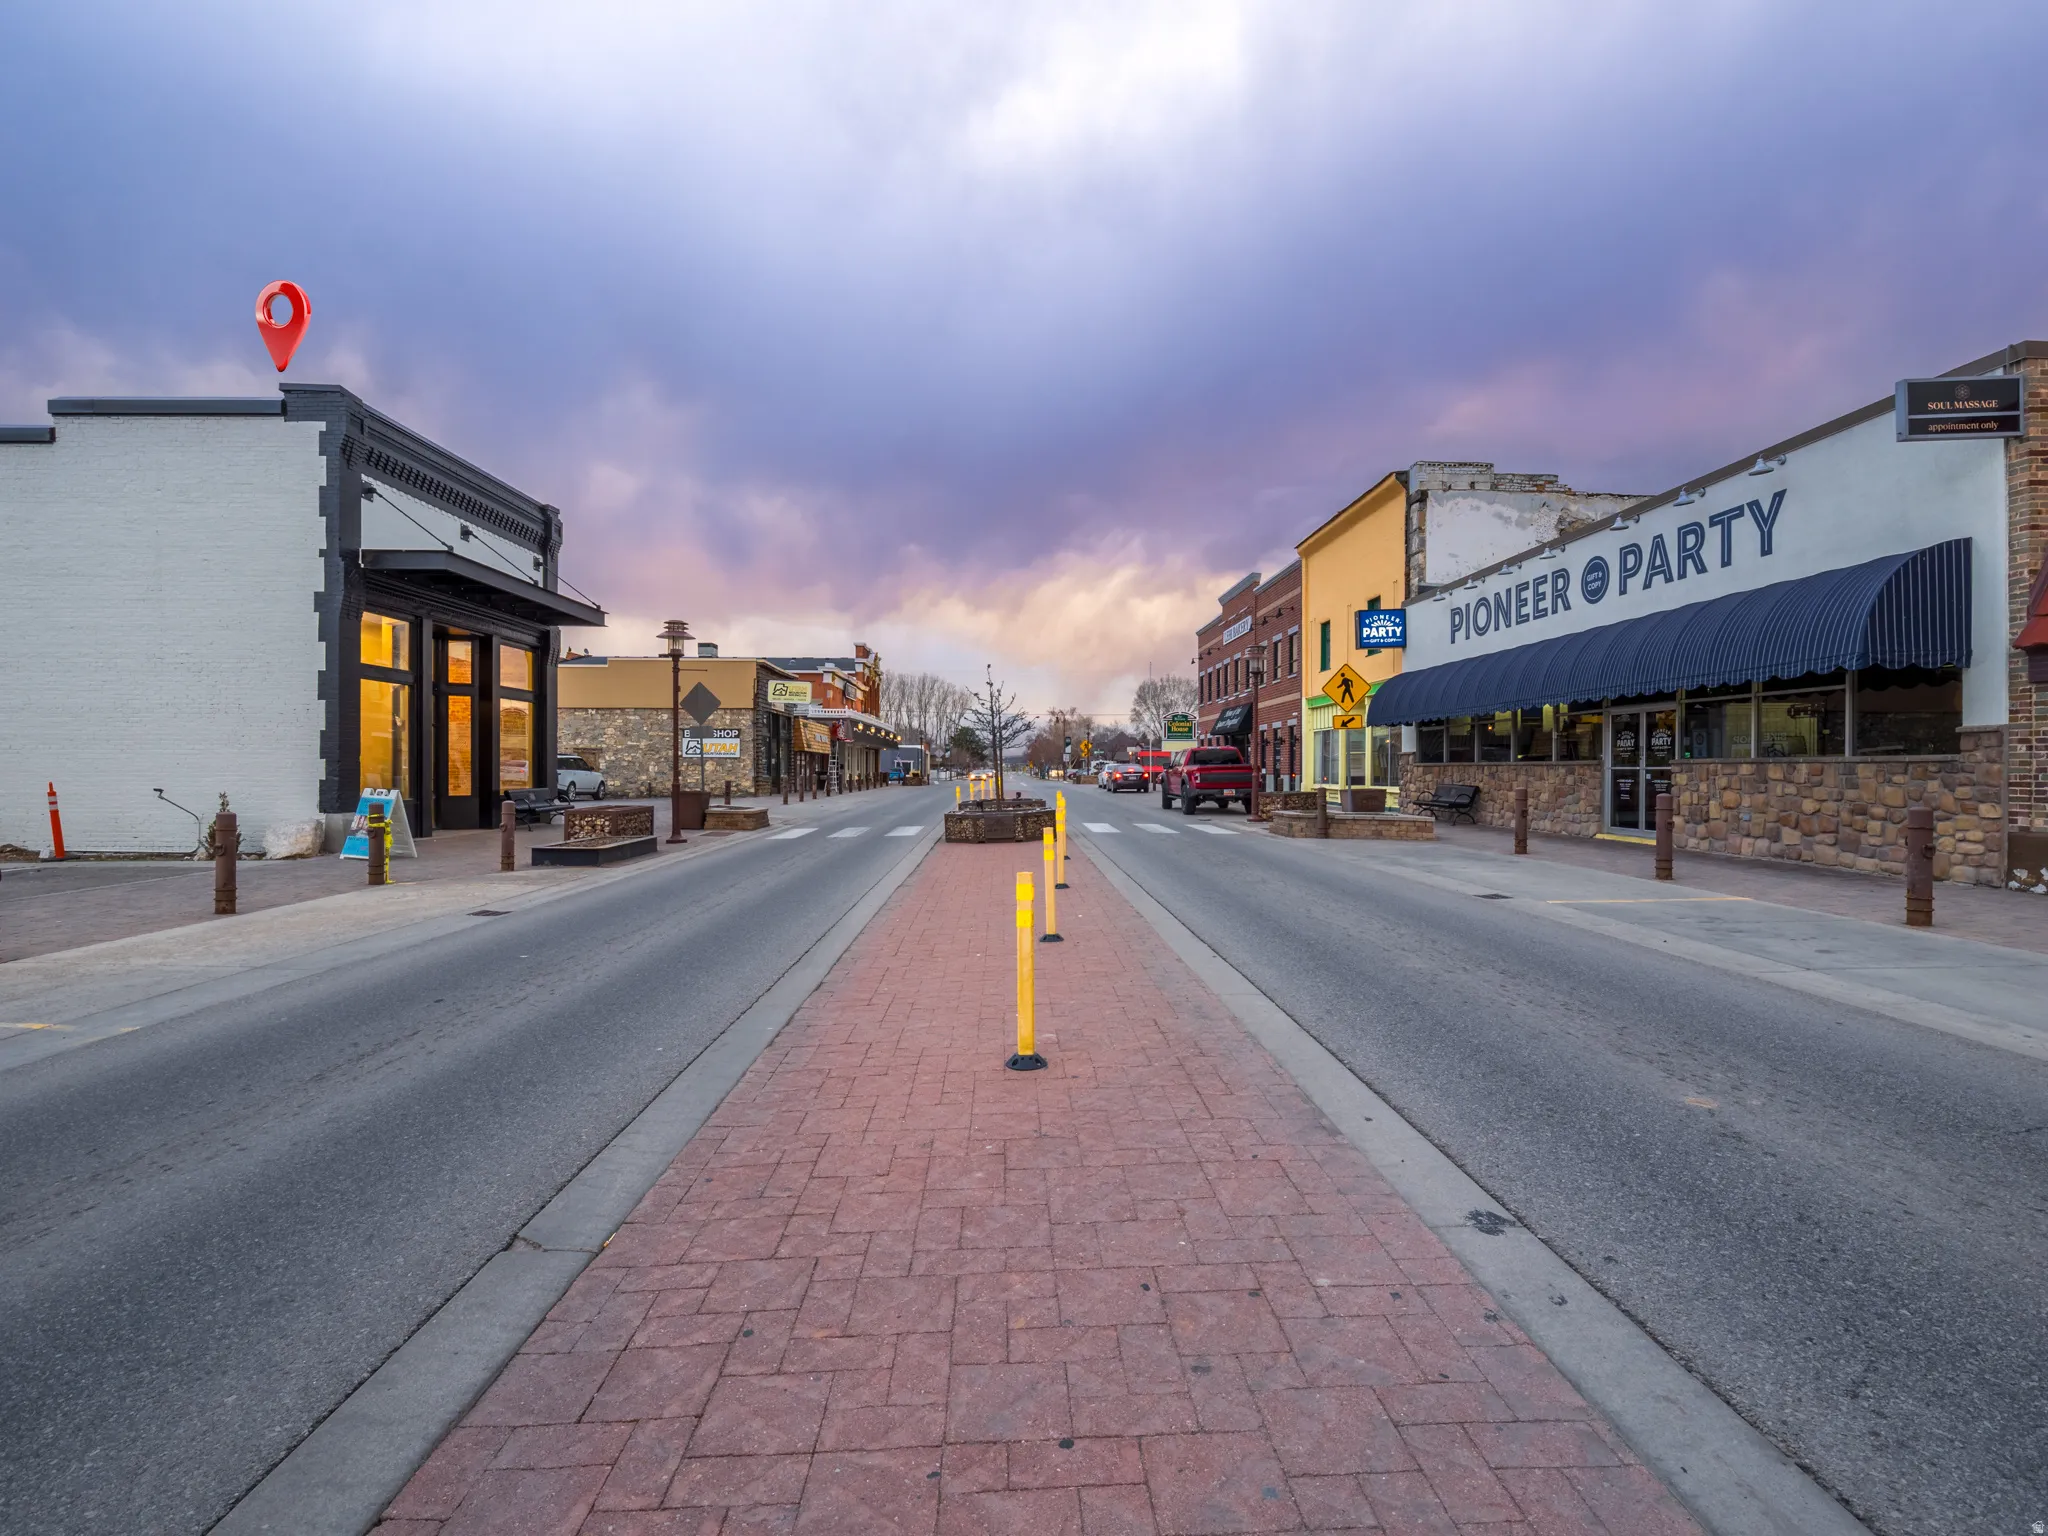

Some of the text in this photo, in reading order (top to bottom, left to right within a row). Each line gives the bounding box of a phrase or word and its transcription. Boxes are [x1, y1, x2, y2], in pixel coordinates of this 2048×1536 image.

[1927, 400, 1999, 410] SOUL MASSAGE
[1928, 421, 1999, 432] appointment only
[1450, 488, 1788, 645] PIONEER PARTY
[1586, 572, 1598, 581] GIFT
[1588, 580, 1601, 590] COPY
[1365, 614, 1400, 624] PIONEER
[1363, 627, 1402, 638] PARTY
[713, 729, 739, 738] SHOP
[1652, 737, 1672, 746] PARTY
[703, 742, 738, 753] UTAH
